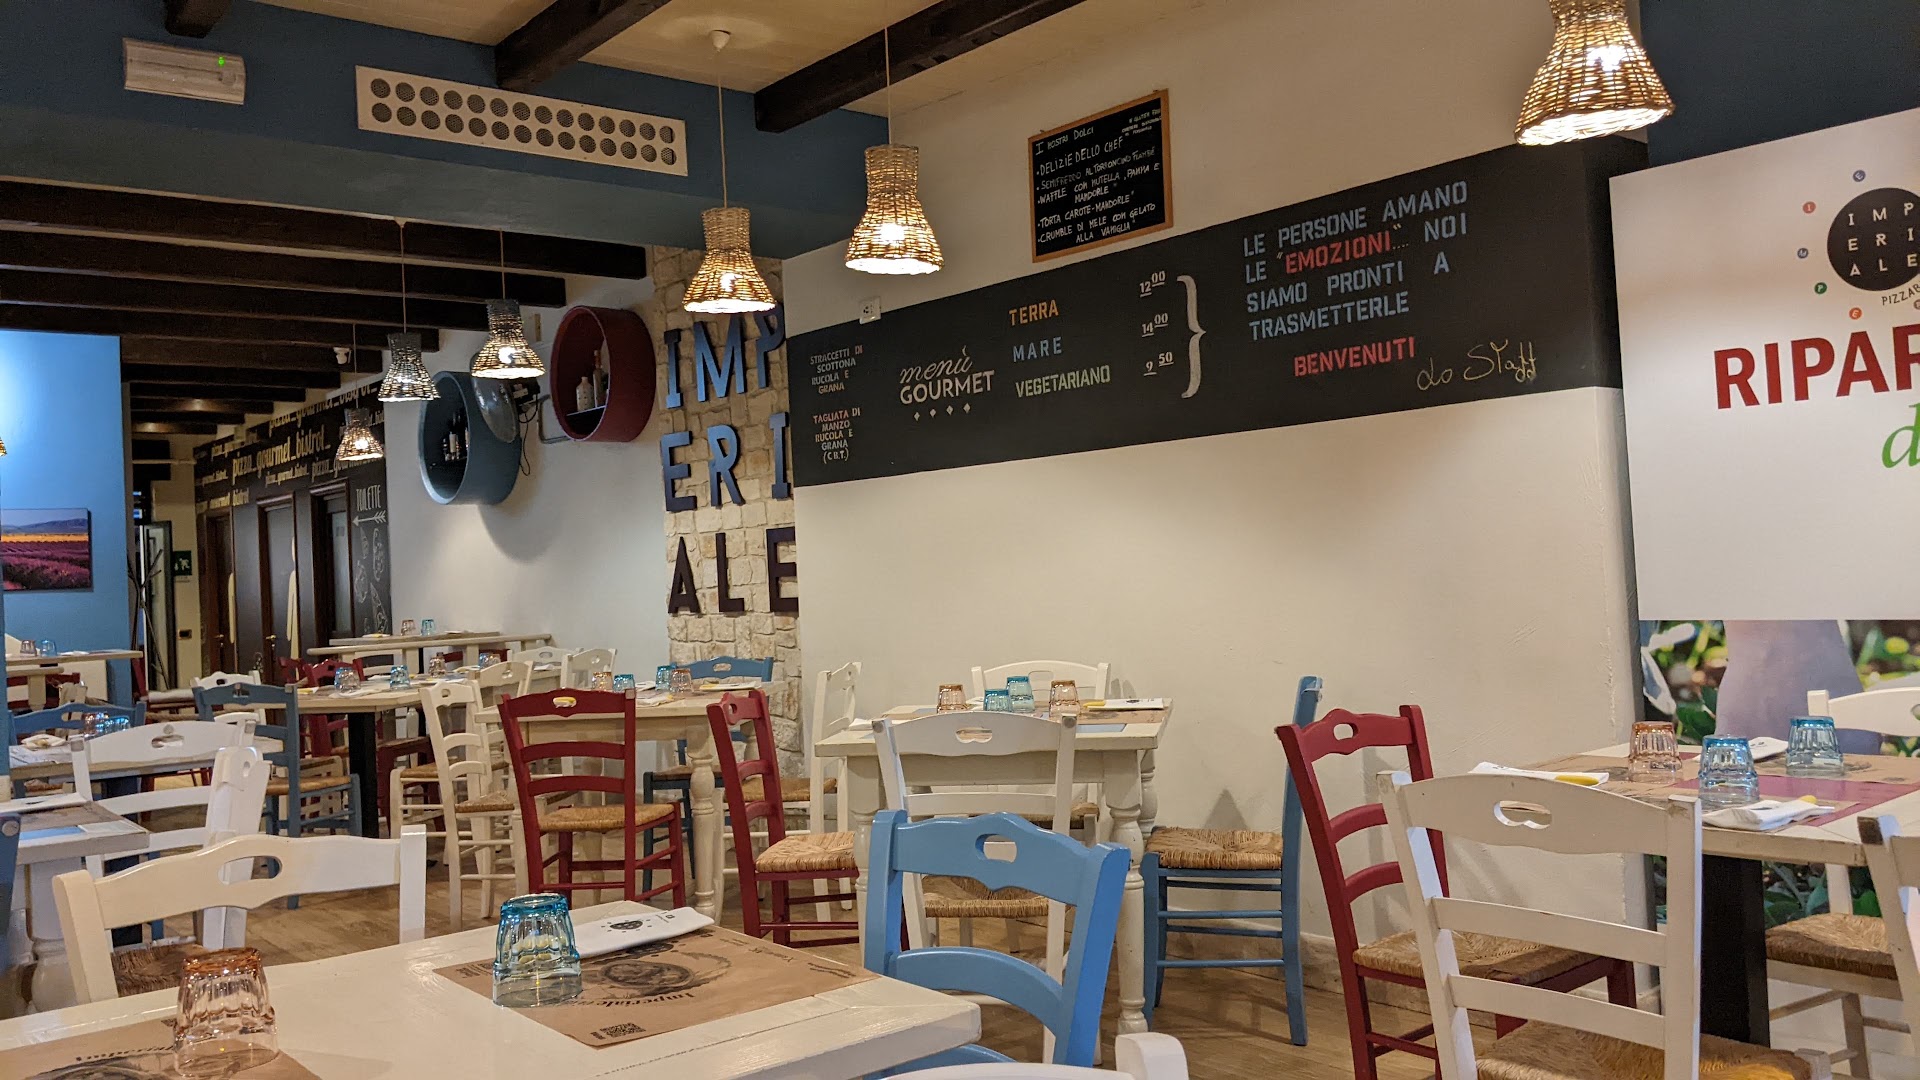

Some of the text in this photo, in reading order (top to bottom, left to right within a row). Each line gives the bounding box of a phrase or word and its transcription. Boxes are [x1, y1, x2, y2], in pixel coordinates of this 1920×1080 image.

[1035, 141, 1044, 155] I
[1073, 127, 1094, 140] DOLCI
[1075, 144, 1100, 163] DELLO
[1104, 136, 1123, 153] CHEF
[1153, 162, 1160, 170] E
[1040, 214, 1061, 229] TORTA
[1040, 224, 1073, 243] CRUMBLE
[1076, 221, 1084, 231] DI
[1129, 203, 1156, 219] GELATO
[1243, 180, 1468, 258] LE PERSONE AMANO
[1076, 231, 1094, 244] ALLA
[1245, 260, 1267, 284] LE
[1424, 212, 1467, 243] NOI
[1247, 251, 1450, 313] SIAMO PRONTI A
[1008, 299, 1059, 326] TERRA
[1249, 290, 1410, 341] TRASMETTERLE
[810, 344, 863, 366] STRACCETTI DI
[1013, 336, 1062, 362] MARE
[1294, 336, 1415, 377] BENVENUTI
[811, 370, 849, 386] RUCOLA E
[817, 357, 856, 374] SCOTTONA
[818, 382, 845, 395] GRANA
[900, 370, 995, 404] GOURMET
[1015, 364, 1111, 398] VEGETARIANO
[813, 407, 861, 424] TAGLIATA DI
[821, 419, 850, 432] MANZO
[815, 428, 853, 442] RUCOLA E
[821, 439, 848, 451] GRANA
